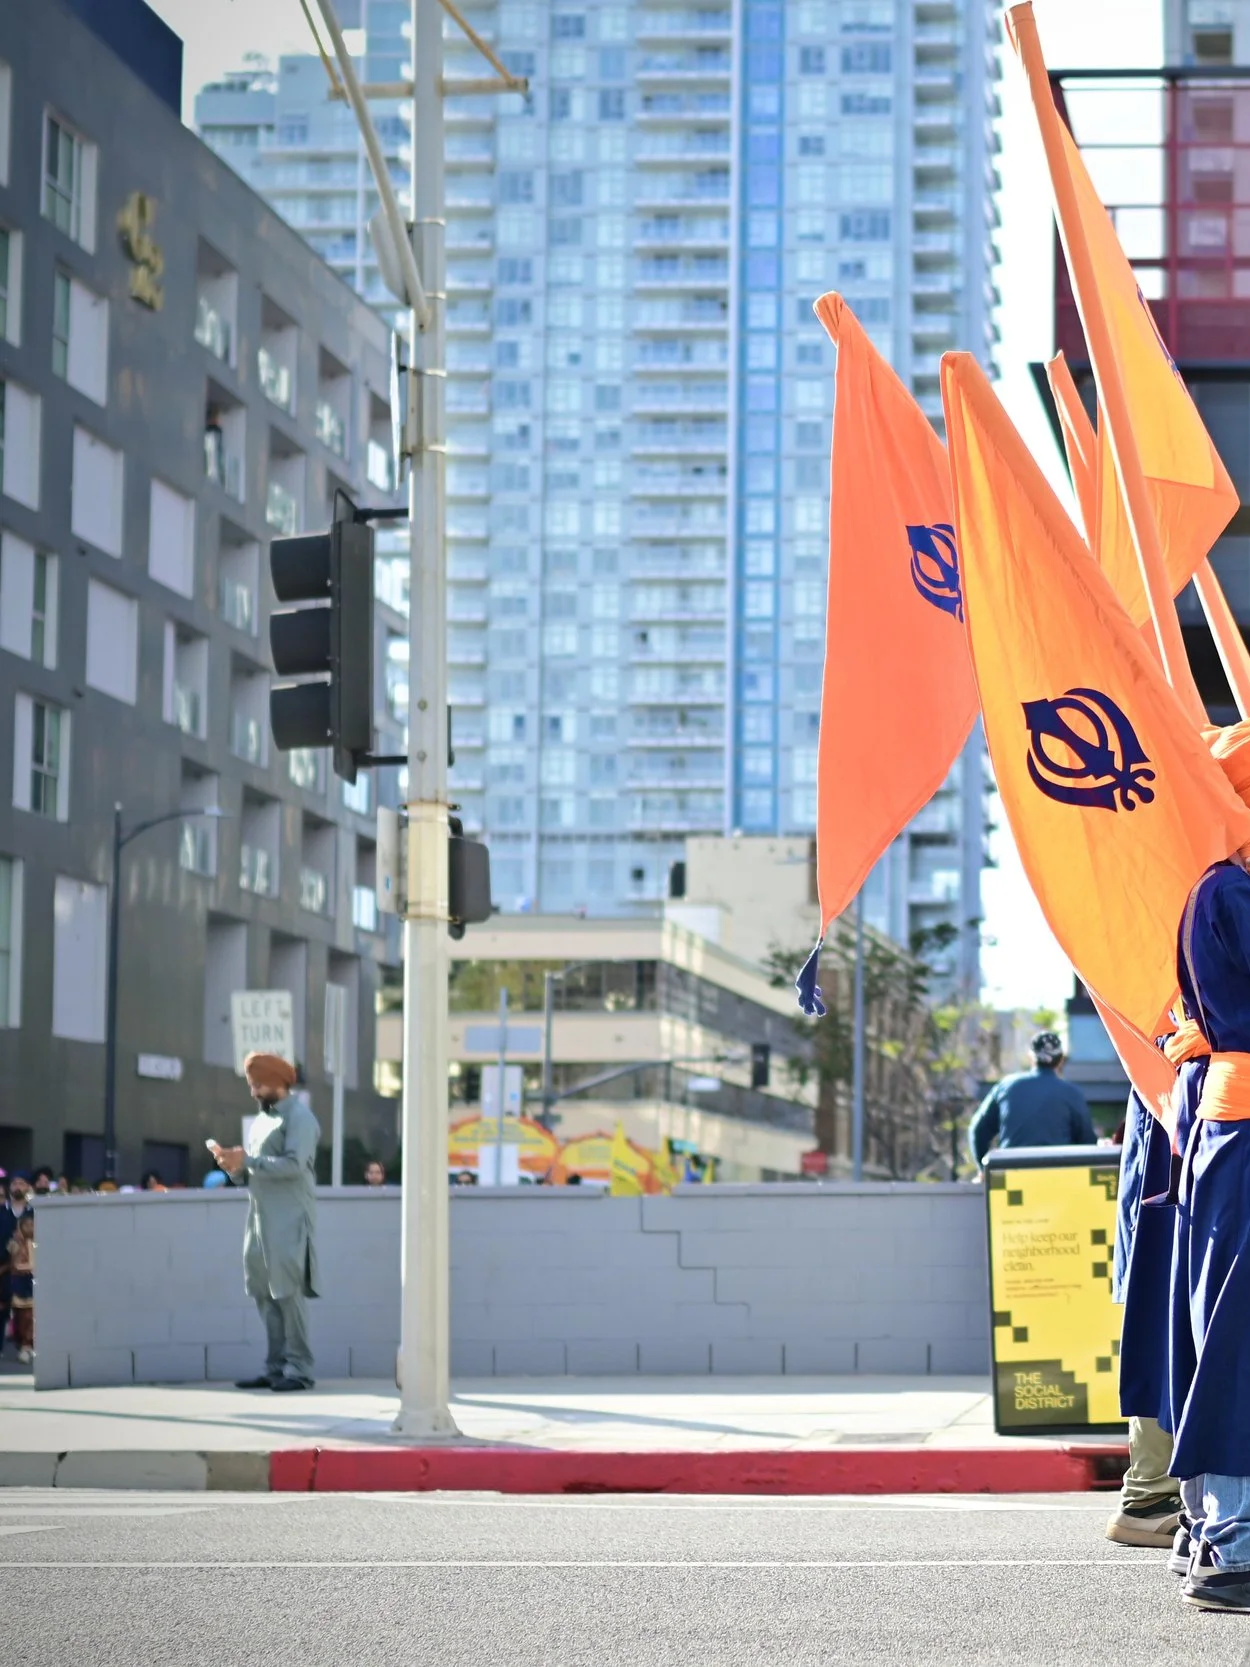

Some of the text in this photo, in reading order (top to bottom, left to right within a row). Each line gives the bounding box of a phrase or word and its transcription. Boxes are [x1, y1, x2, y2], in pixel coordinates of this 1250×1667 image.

[241, 1000, 285, 1018] LEFT
[242, 1023, 284, 1042] TURN
[1002, 1232, 1078, 1246] Help keep our
[1003, 1243, 1080, 1259] neighborhood
[1003, 1260, 1035, 1272] clean.
[1014, 1372, 1042, 1385] THE
[1014, 1384, 1064, 1398] SOCIAL
[1015, 1396, 1075, 1410] DISTRICT
